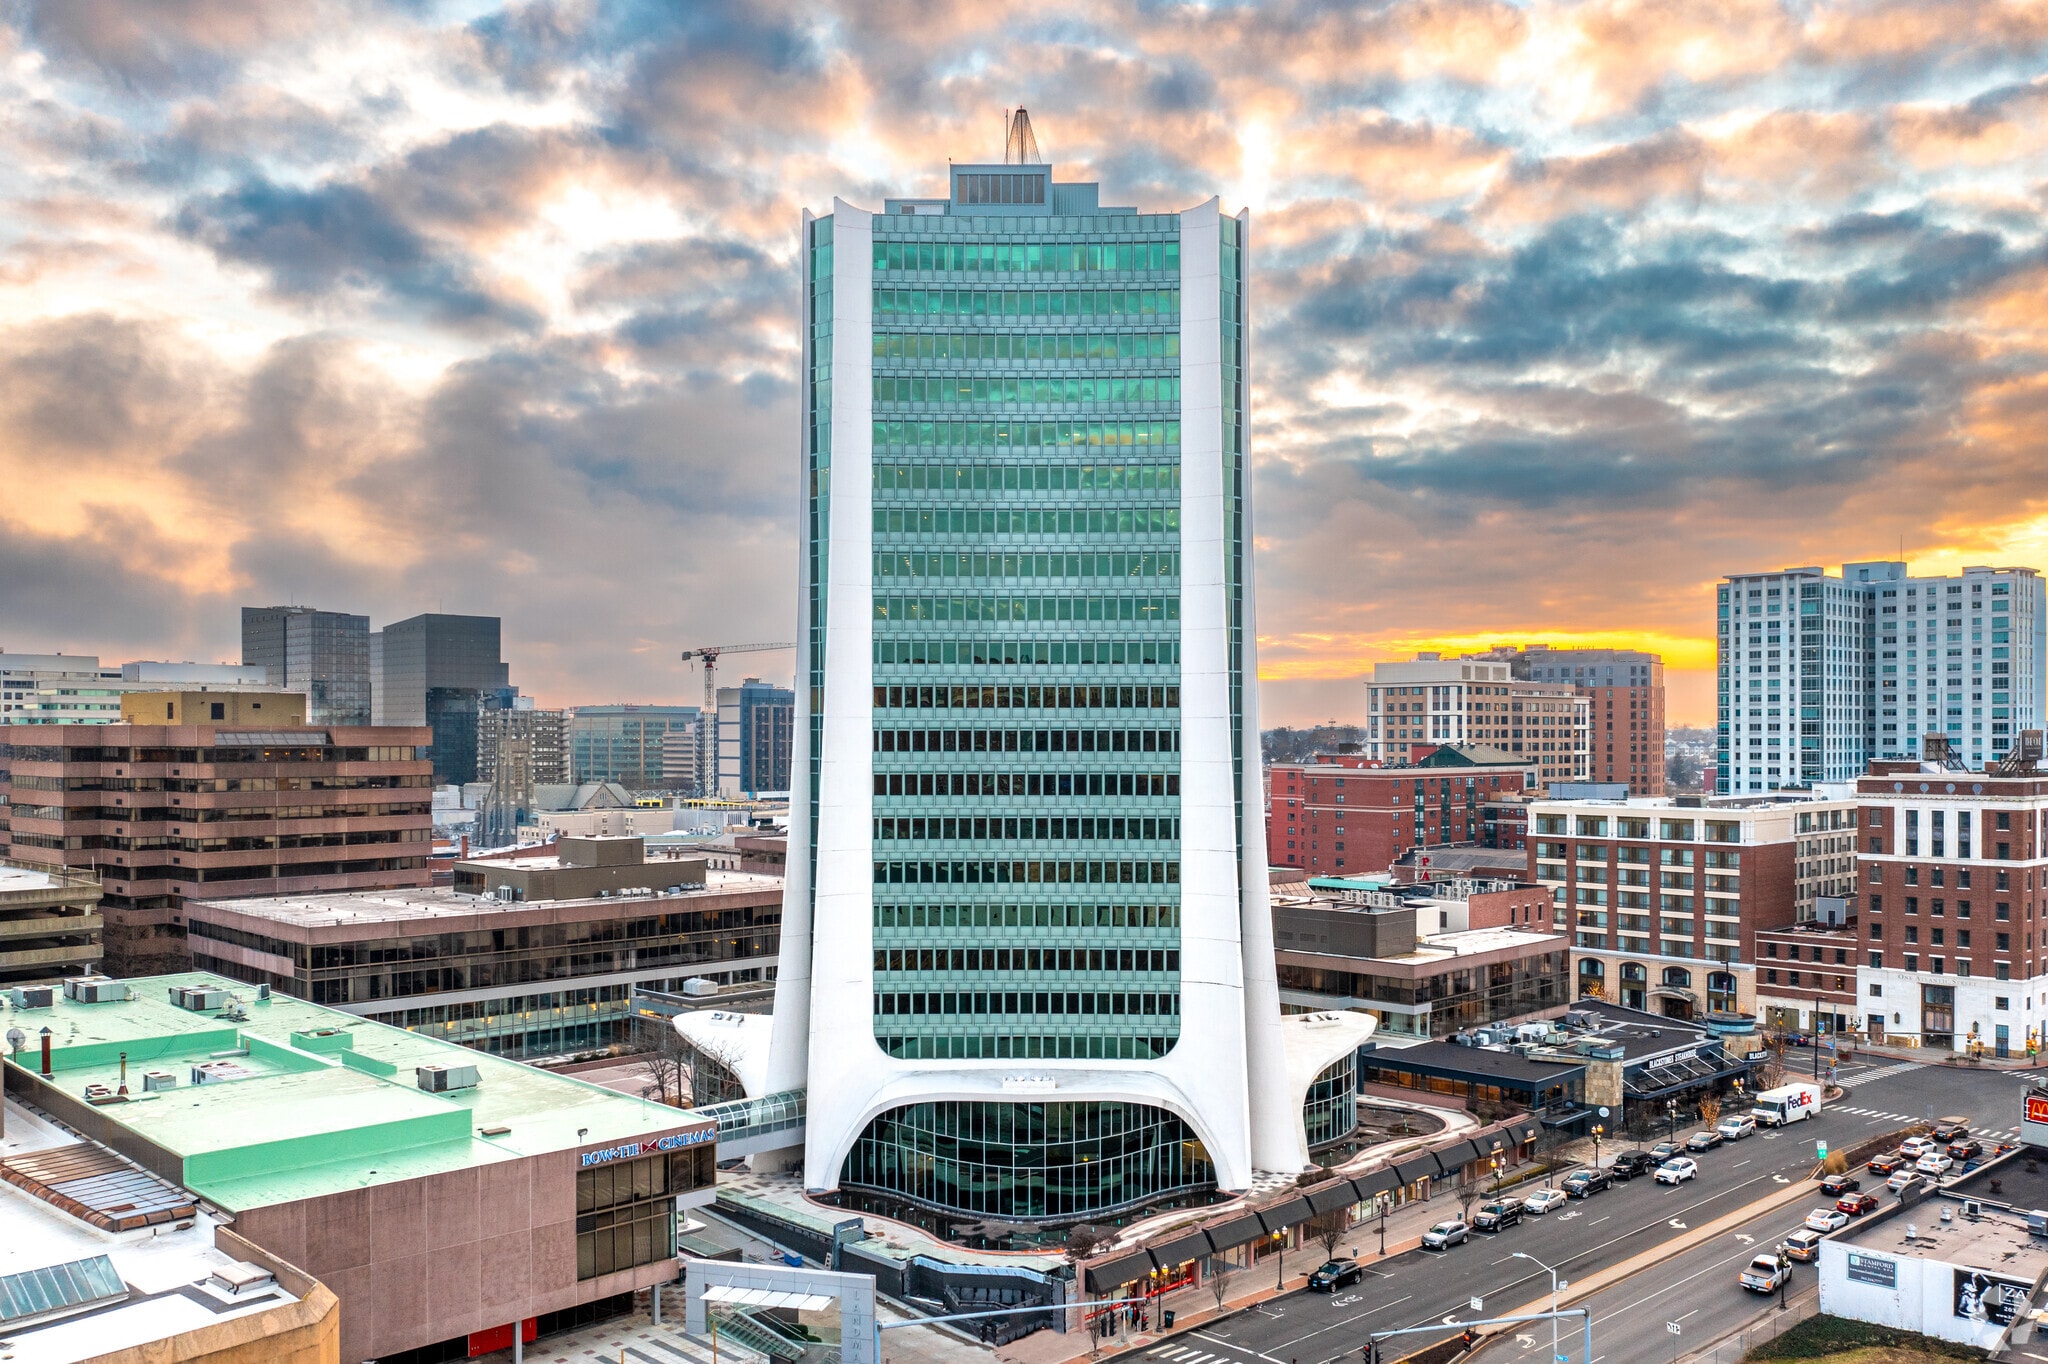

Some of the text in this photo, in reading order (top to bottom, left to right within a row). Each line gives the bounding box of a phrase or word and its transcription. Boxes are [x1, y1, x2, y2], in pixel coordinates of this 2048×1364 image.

[1787, 1091, 1812, 1110] FedEx
[658, 1128, 715, 1150] CINEMAS
[1860, 1258, 1894, 1269] STAMFORD
